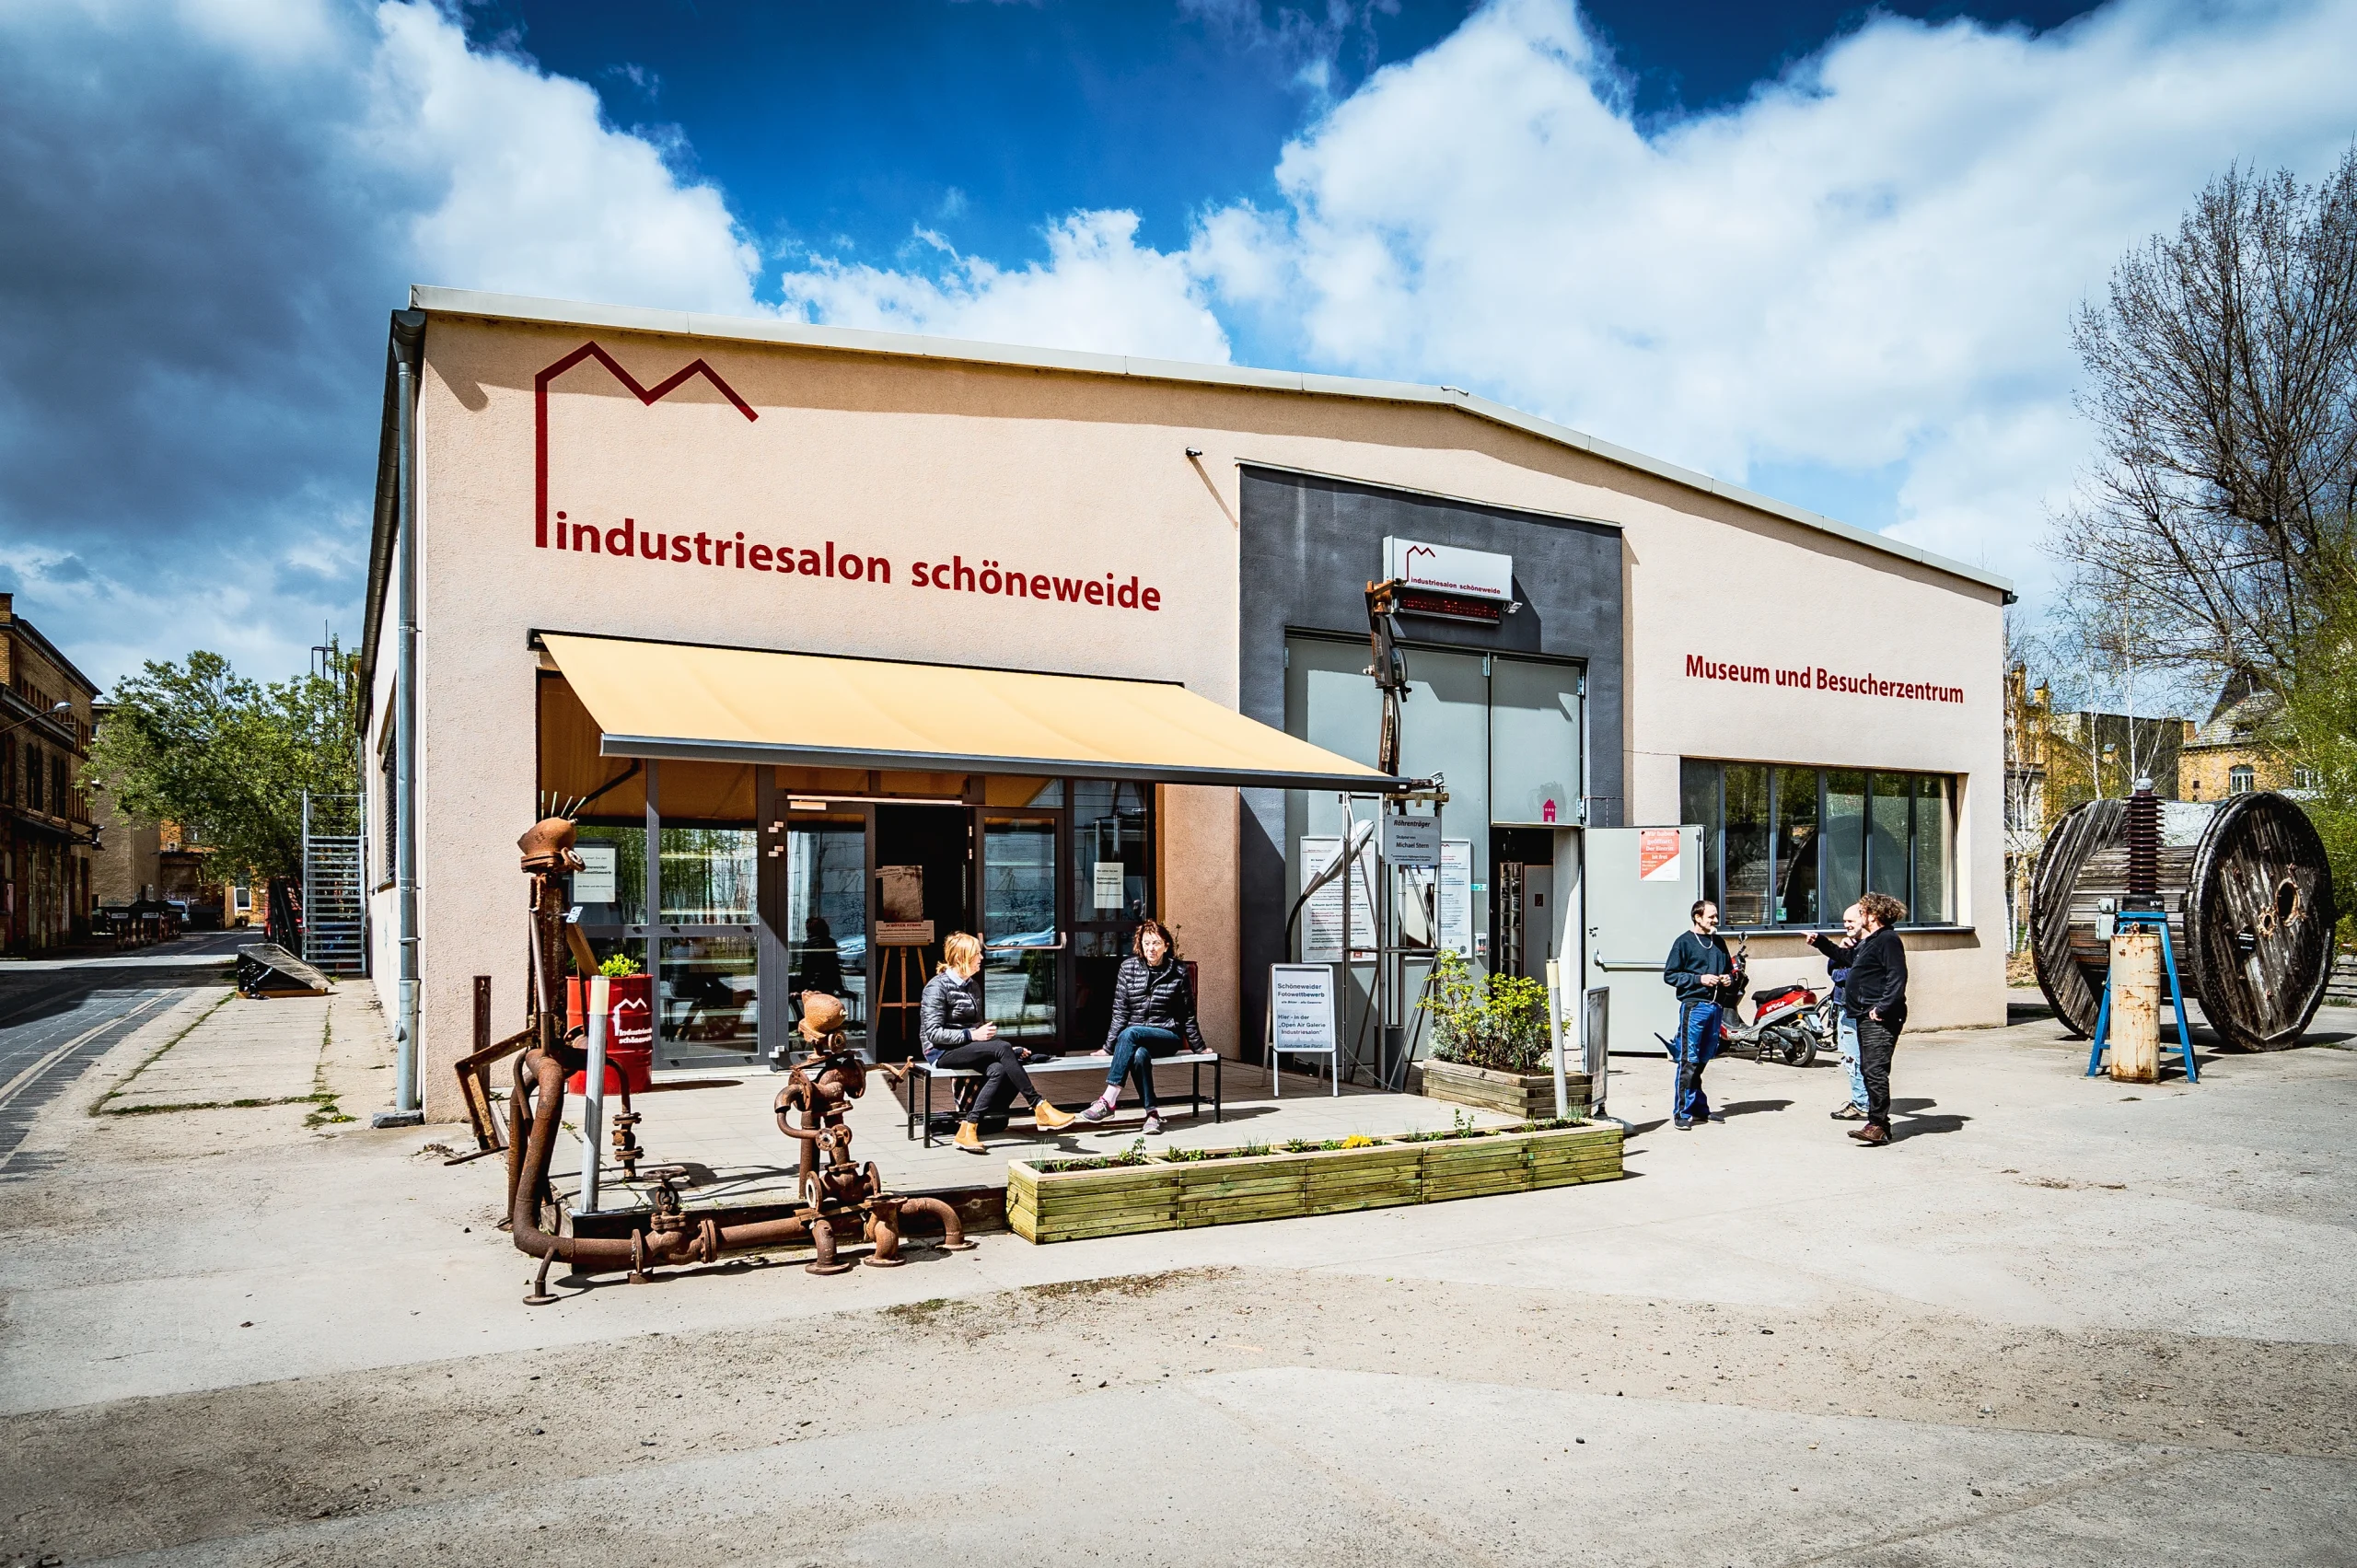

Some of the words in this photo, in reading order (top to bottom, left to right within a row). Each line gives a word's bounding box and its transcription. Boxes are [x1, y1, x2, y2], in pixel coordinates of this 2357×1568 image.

[556, 510, 891, 584] industriesalon
[911, 555, 1161, 611] schöneweide
[1411, 576, 1457, 588] industriesalon
[1459, 583, 1501, 595] schöneweide
[1686, 654, 1770, 684] Museum
[1775, 666, 1811, 689] und
[1817, 668, 1964, 703] Besucherzentrum
[1393, 819, 1431, 829] Röhrenträger
